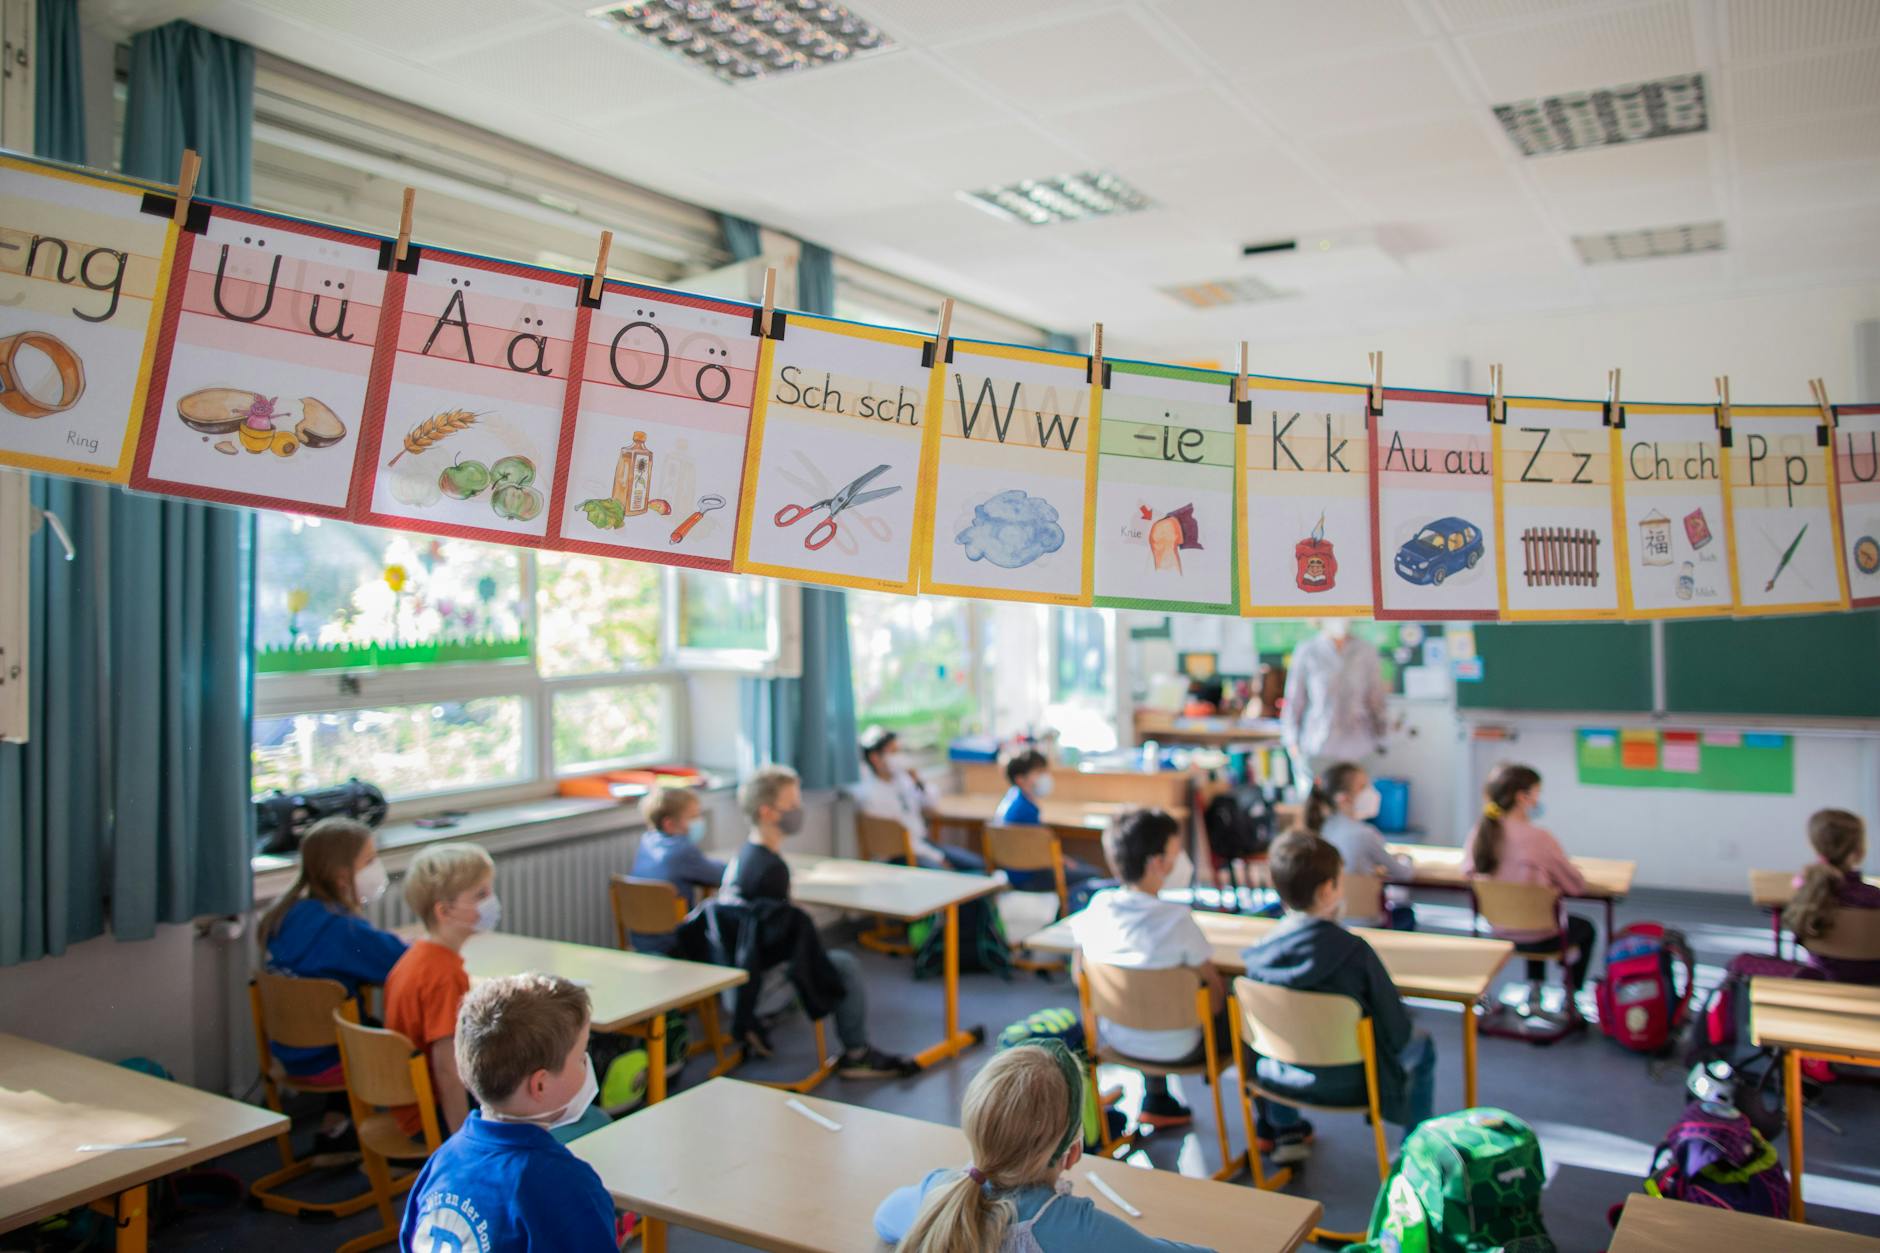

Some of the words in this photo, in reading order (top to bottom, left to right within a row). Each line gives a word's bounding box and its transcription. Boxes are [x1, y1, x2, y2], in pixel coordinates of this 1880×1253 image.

[213, 236, 282, 322] Ü
[309, 279, 354, 340] ü
[421, 277, 476, 363] Ä
[507, 316, 553, 375] ä
[610, 309, 669, 389] Ö
[695, 347, 731, 402] ö
[776, 366, 845, 413] Sch
[859, 385, 919, 426] sch
[955, 373, 1021, 442] W
[66, 430, 99, 453] Ring
[1134, 411, 1205, 464] -ie
[1272, 411, 1304, 470] K
[1326, 413, 1350, 472] k
[1385, 431, 1432, 473] Au
[1444, 448, 1489, 475] au
[1520, 427, 1553, 483] Z
[1571, 453, 1593, 484] z
[1630, 442, 1673, 480] Ch
[1683, 442, 1719, 480] ch
[1747, 434, 1767, 486] P
[1785, 456, 1808, 508] p
[1120, 526, 1142, 538] Knie
[461, 1198, 480, 1222] der
